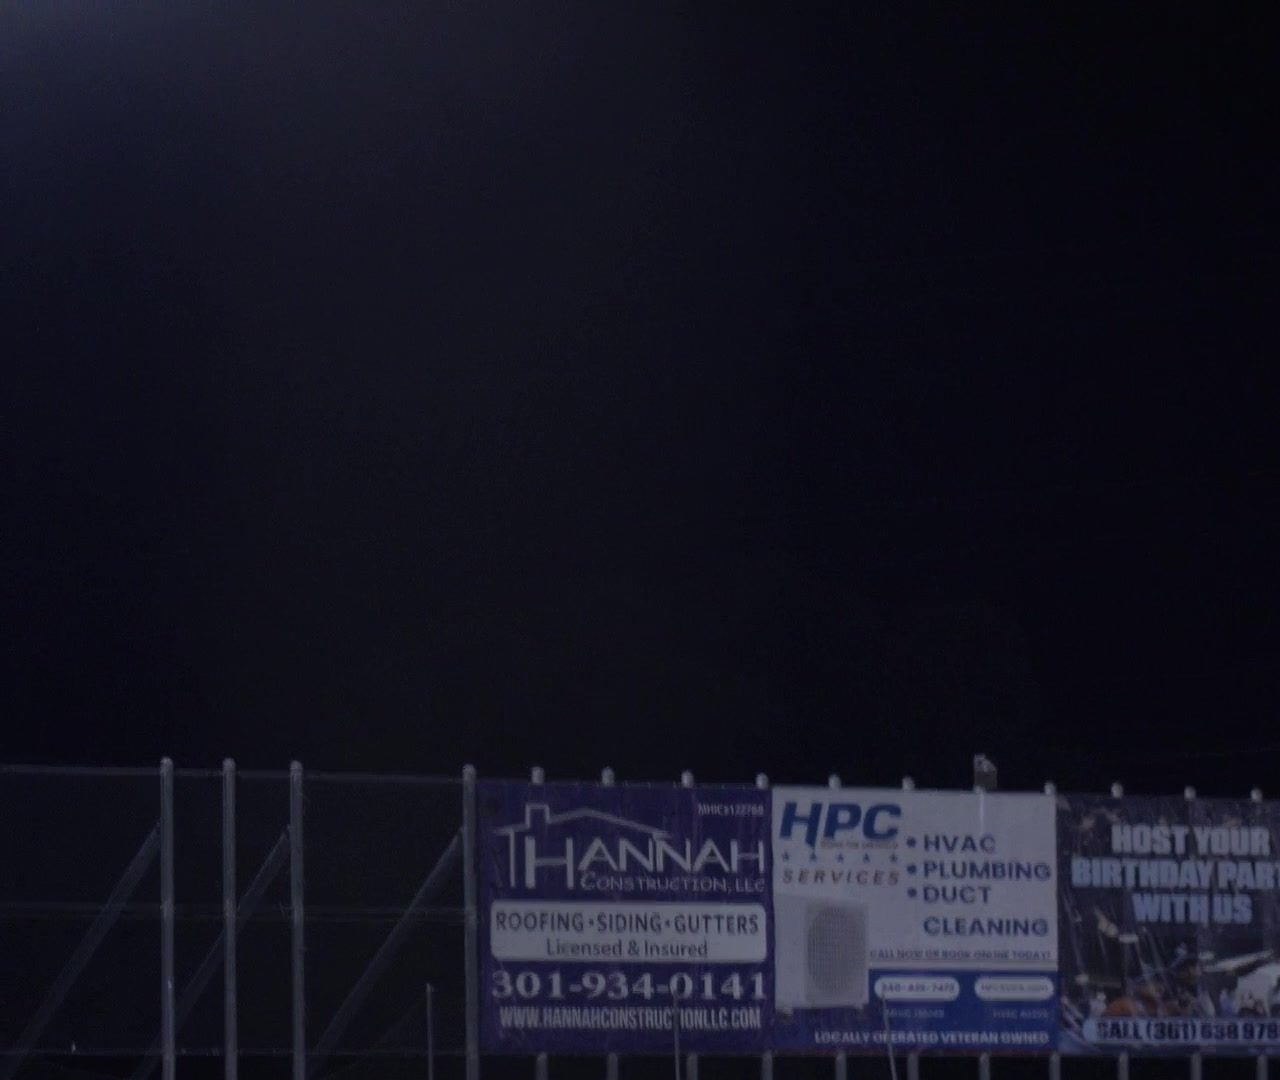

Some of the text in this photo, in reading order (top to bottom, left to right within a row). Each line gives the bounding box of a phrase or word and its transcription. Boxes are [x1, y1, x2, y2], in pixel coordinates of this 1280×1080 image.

[779, 802, 902, 848] HPC
[923, 835, 996, 853] HVAC
[1112, 824, 1270, 856] HOST YOUR
[525, 835, 764, 889] HANNAH
[923, 861, 1051, 880] PLUMBING
[1071, 857, 1214, 888] BIRTHDAY
[735, 878, 765, 892] LLC
[783, 870, 899, 886] SERVICES
[923, 886, 992, 904] DUCT
[1132, 894, 1253, 924] WITH US
[496, 912, 759, 935] ROOFING SIDING GUTTERS
[923, 916, 1049, 937] CLEANING
[547, 939, 708, 957] Licensed & Insured
[492, 970, 766, 1000] 301-934-0141
[1097, 1022, 1142, 1040] CALL
